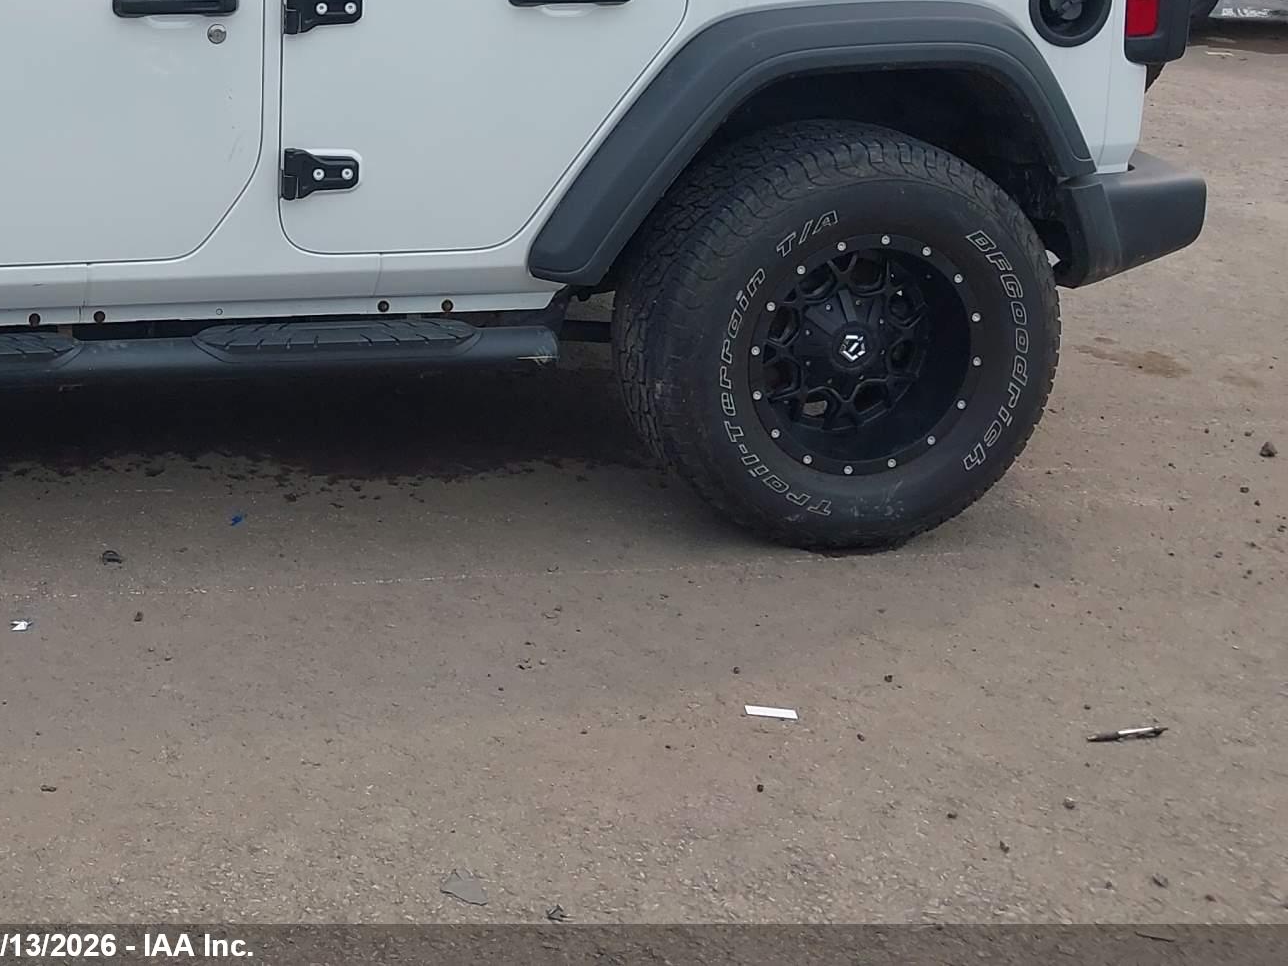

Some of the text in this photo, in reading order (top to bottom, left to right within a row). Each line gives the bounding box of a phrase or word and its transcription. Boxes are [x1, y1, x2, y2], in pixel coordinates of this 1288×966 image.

[717, 209, 841, 517] Trail-Terrain T/A
[962, 229, 1030, 472] BFGoodrich
